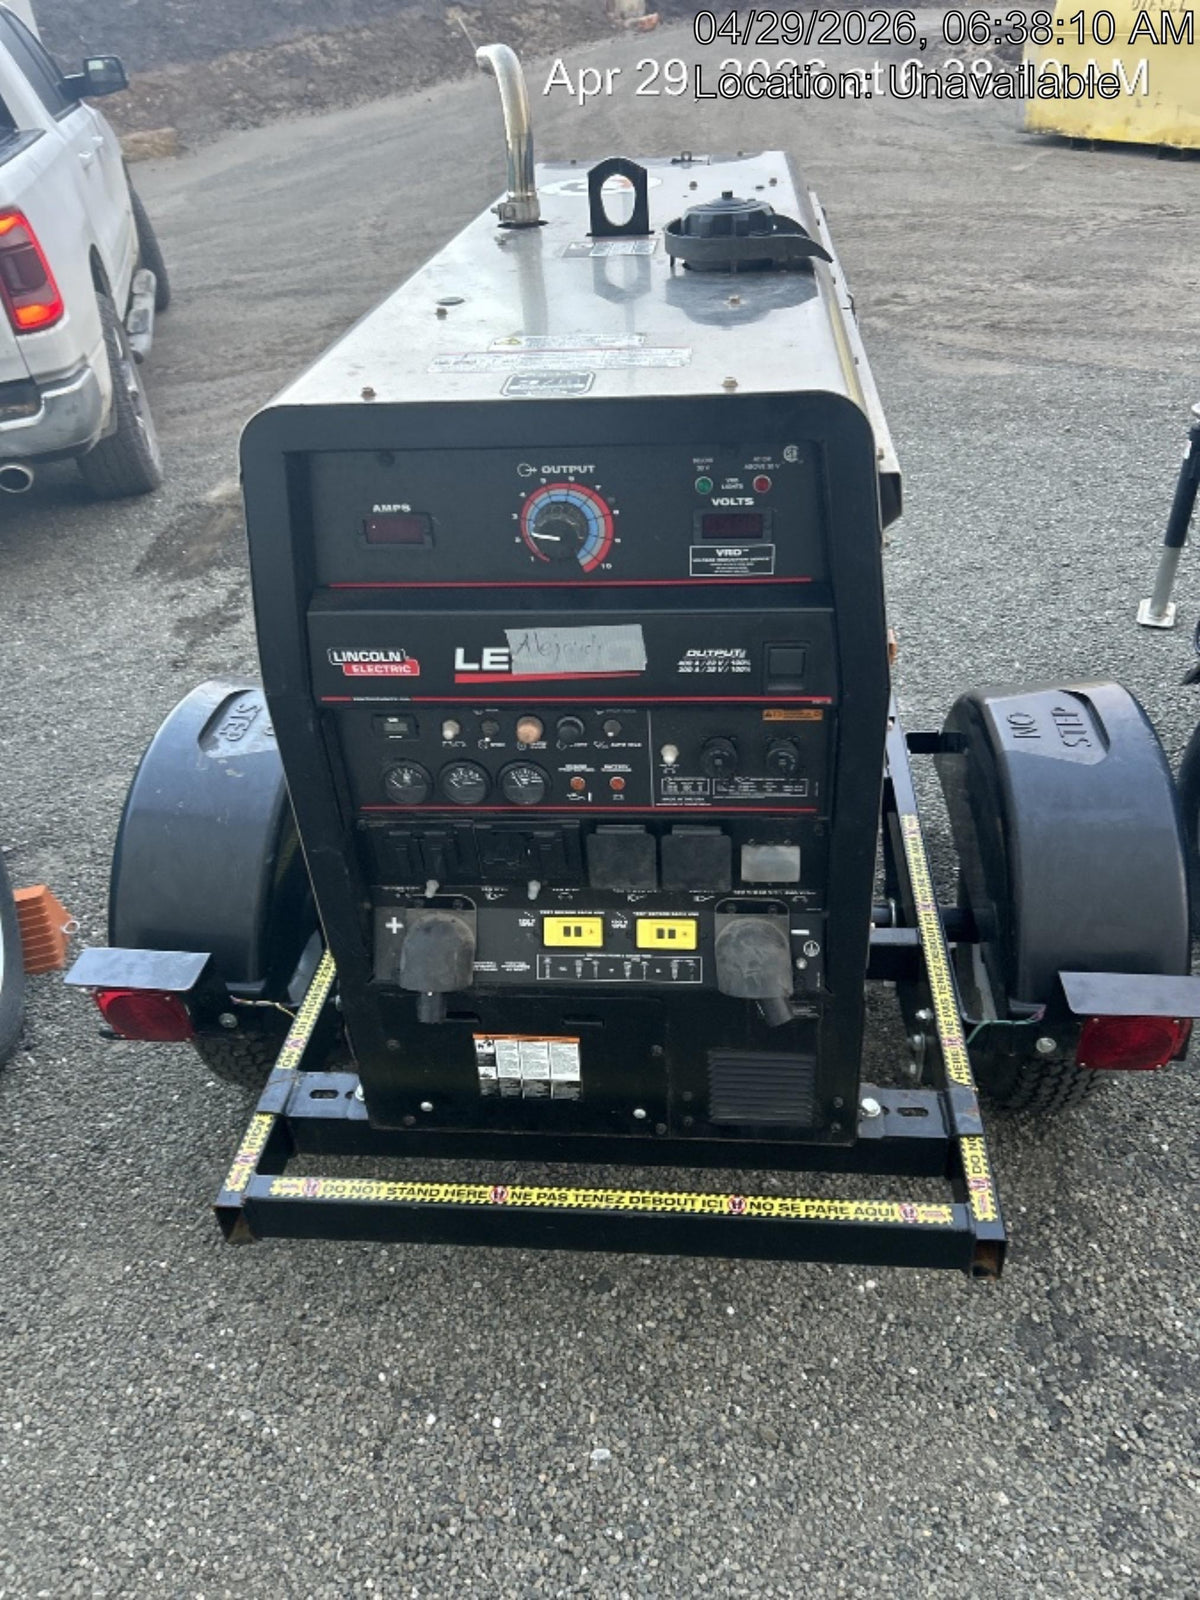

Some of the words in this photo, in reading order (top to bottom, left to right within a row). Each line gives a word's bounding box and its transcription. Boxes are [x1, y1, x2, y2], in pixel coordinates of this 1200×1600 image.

[541, 465, 596, 474] OUTPUT
[372, 503, 411, 513] AMPS
[711, 497, 755, 506] VOLTS
[333, 651, 402, 662] LINCOLN
[351, 664, 412, 673] ELECTRIC
[1006, 711, 1041, 738] NO
[1050, 707, 1092, 747] STEP
[282, 1051, 295, 1068] NO
[970, 1155, 982, 1174] DO
[323, 1181, 346, 1194] DO
[349, 1181, 383, 1195] NOT
[386, 1183, 440, 1197] STAND
[443, 1185, 488, 1199] HERE
[511, 1191, 533, 1201] NE
[536, 1192, 569, 1202] PAS
[574, 1193, 625, 1205] TENEZ
[628, 1195, 698, 1208] DEBOUT
[701, 1197, 723, 1209] ICI
[749, 1200, 774, 1212] NO
[778, 1202, 801, 1213] SE
[804, 1204, 851, 1215] PARE
